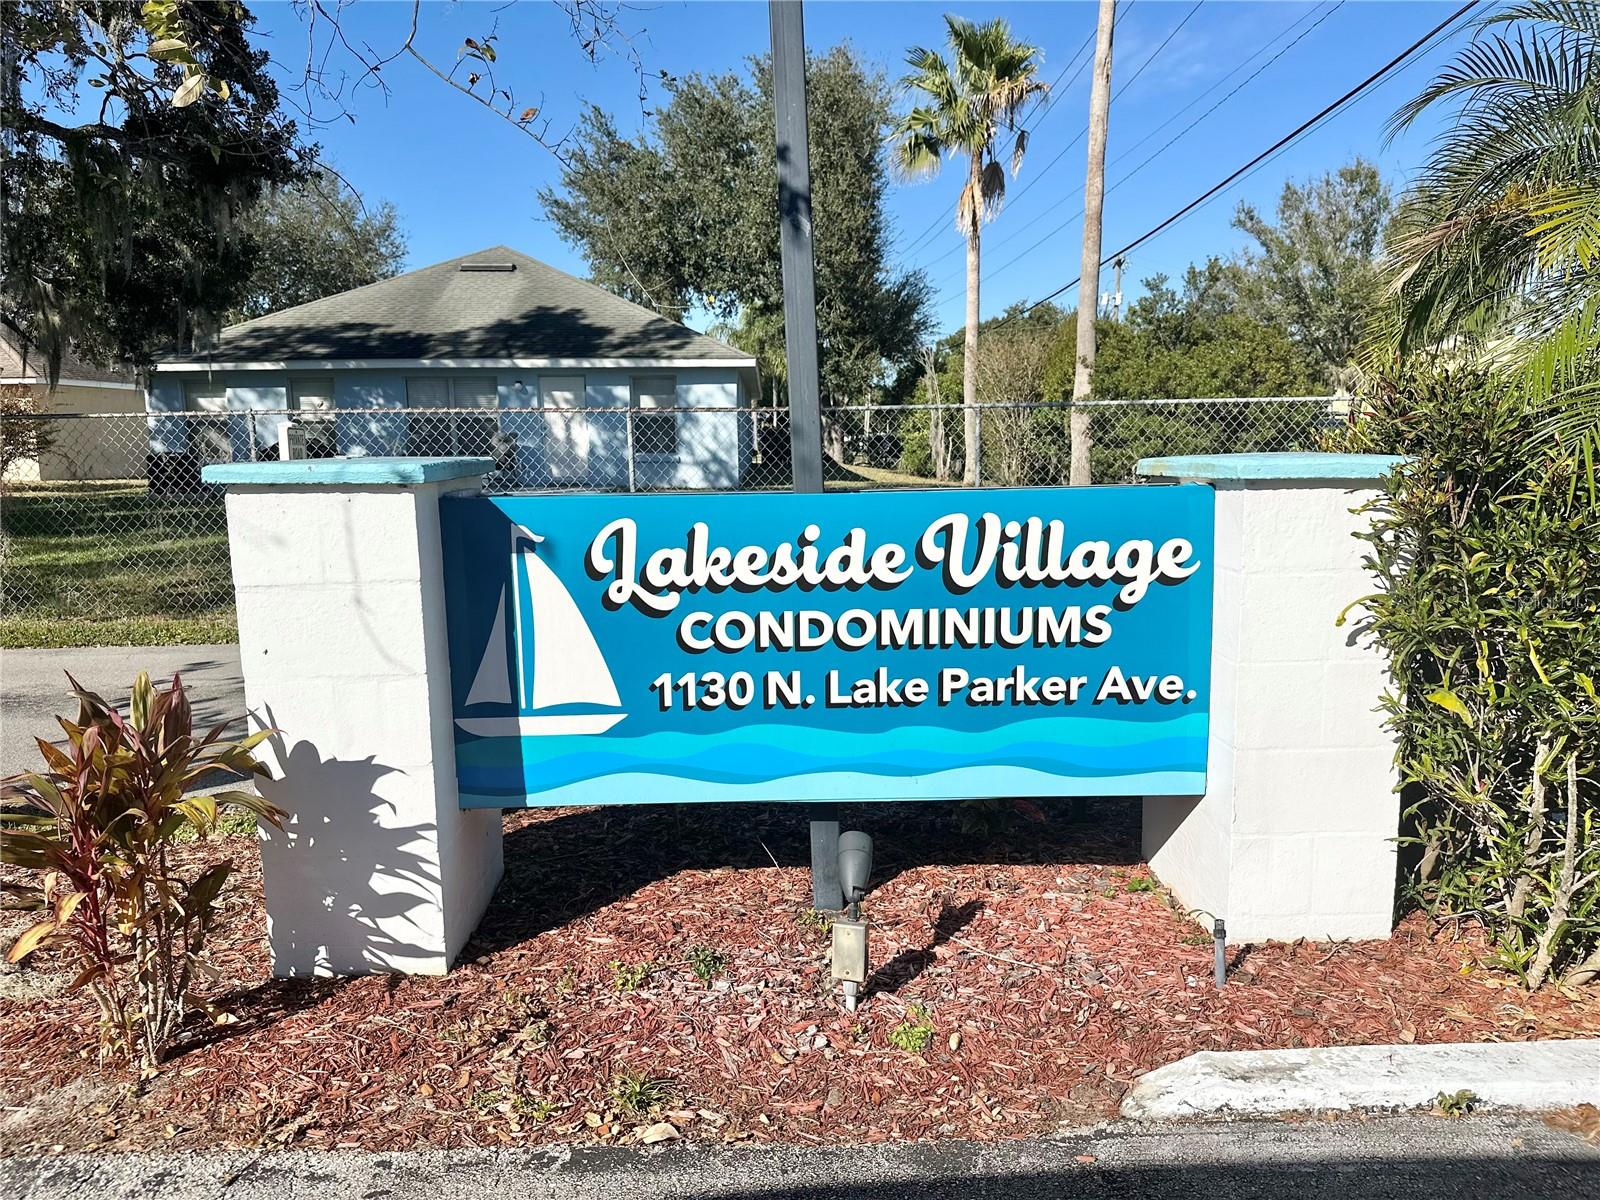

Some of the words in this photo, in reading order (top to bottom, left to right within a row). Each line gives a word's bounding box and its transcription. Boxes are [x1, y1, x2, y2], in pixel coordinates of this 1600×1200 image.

[587, 517, 914, 614] Lakeside
[916, 511, 1201, 609] Village
[678, 604, 1112, 652] CONDOMINIUMS
[651, 671, 755, 709] 1130
[764, 670, 816, 708] N.
[827, 666, 929, 706] Lake
[939, 665, 1088, 704] Parker
[1094, 666, 1197, 703] Ave.
